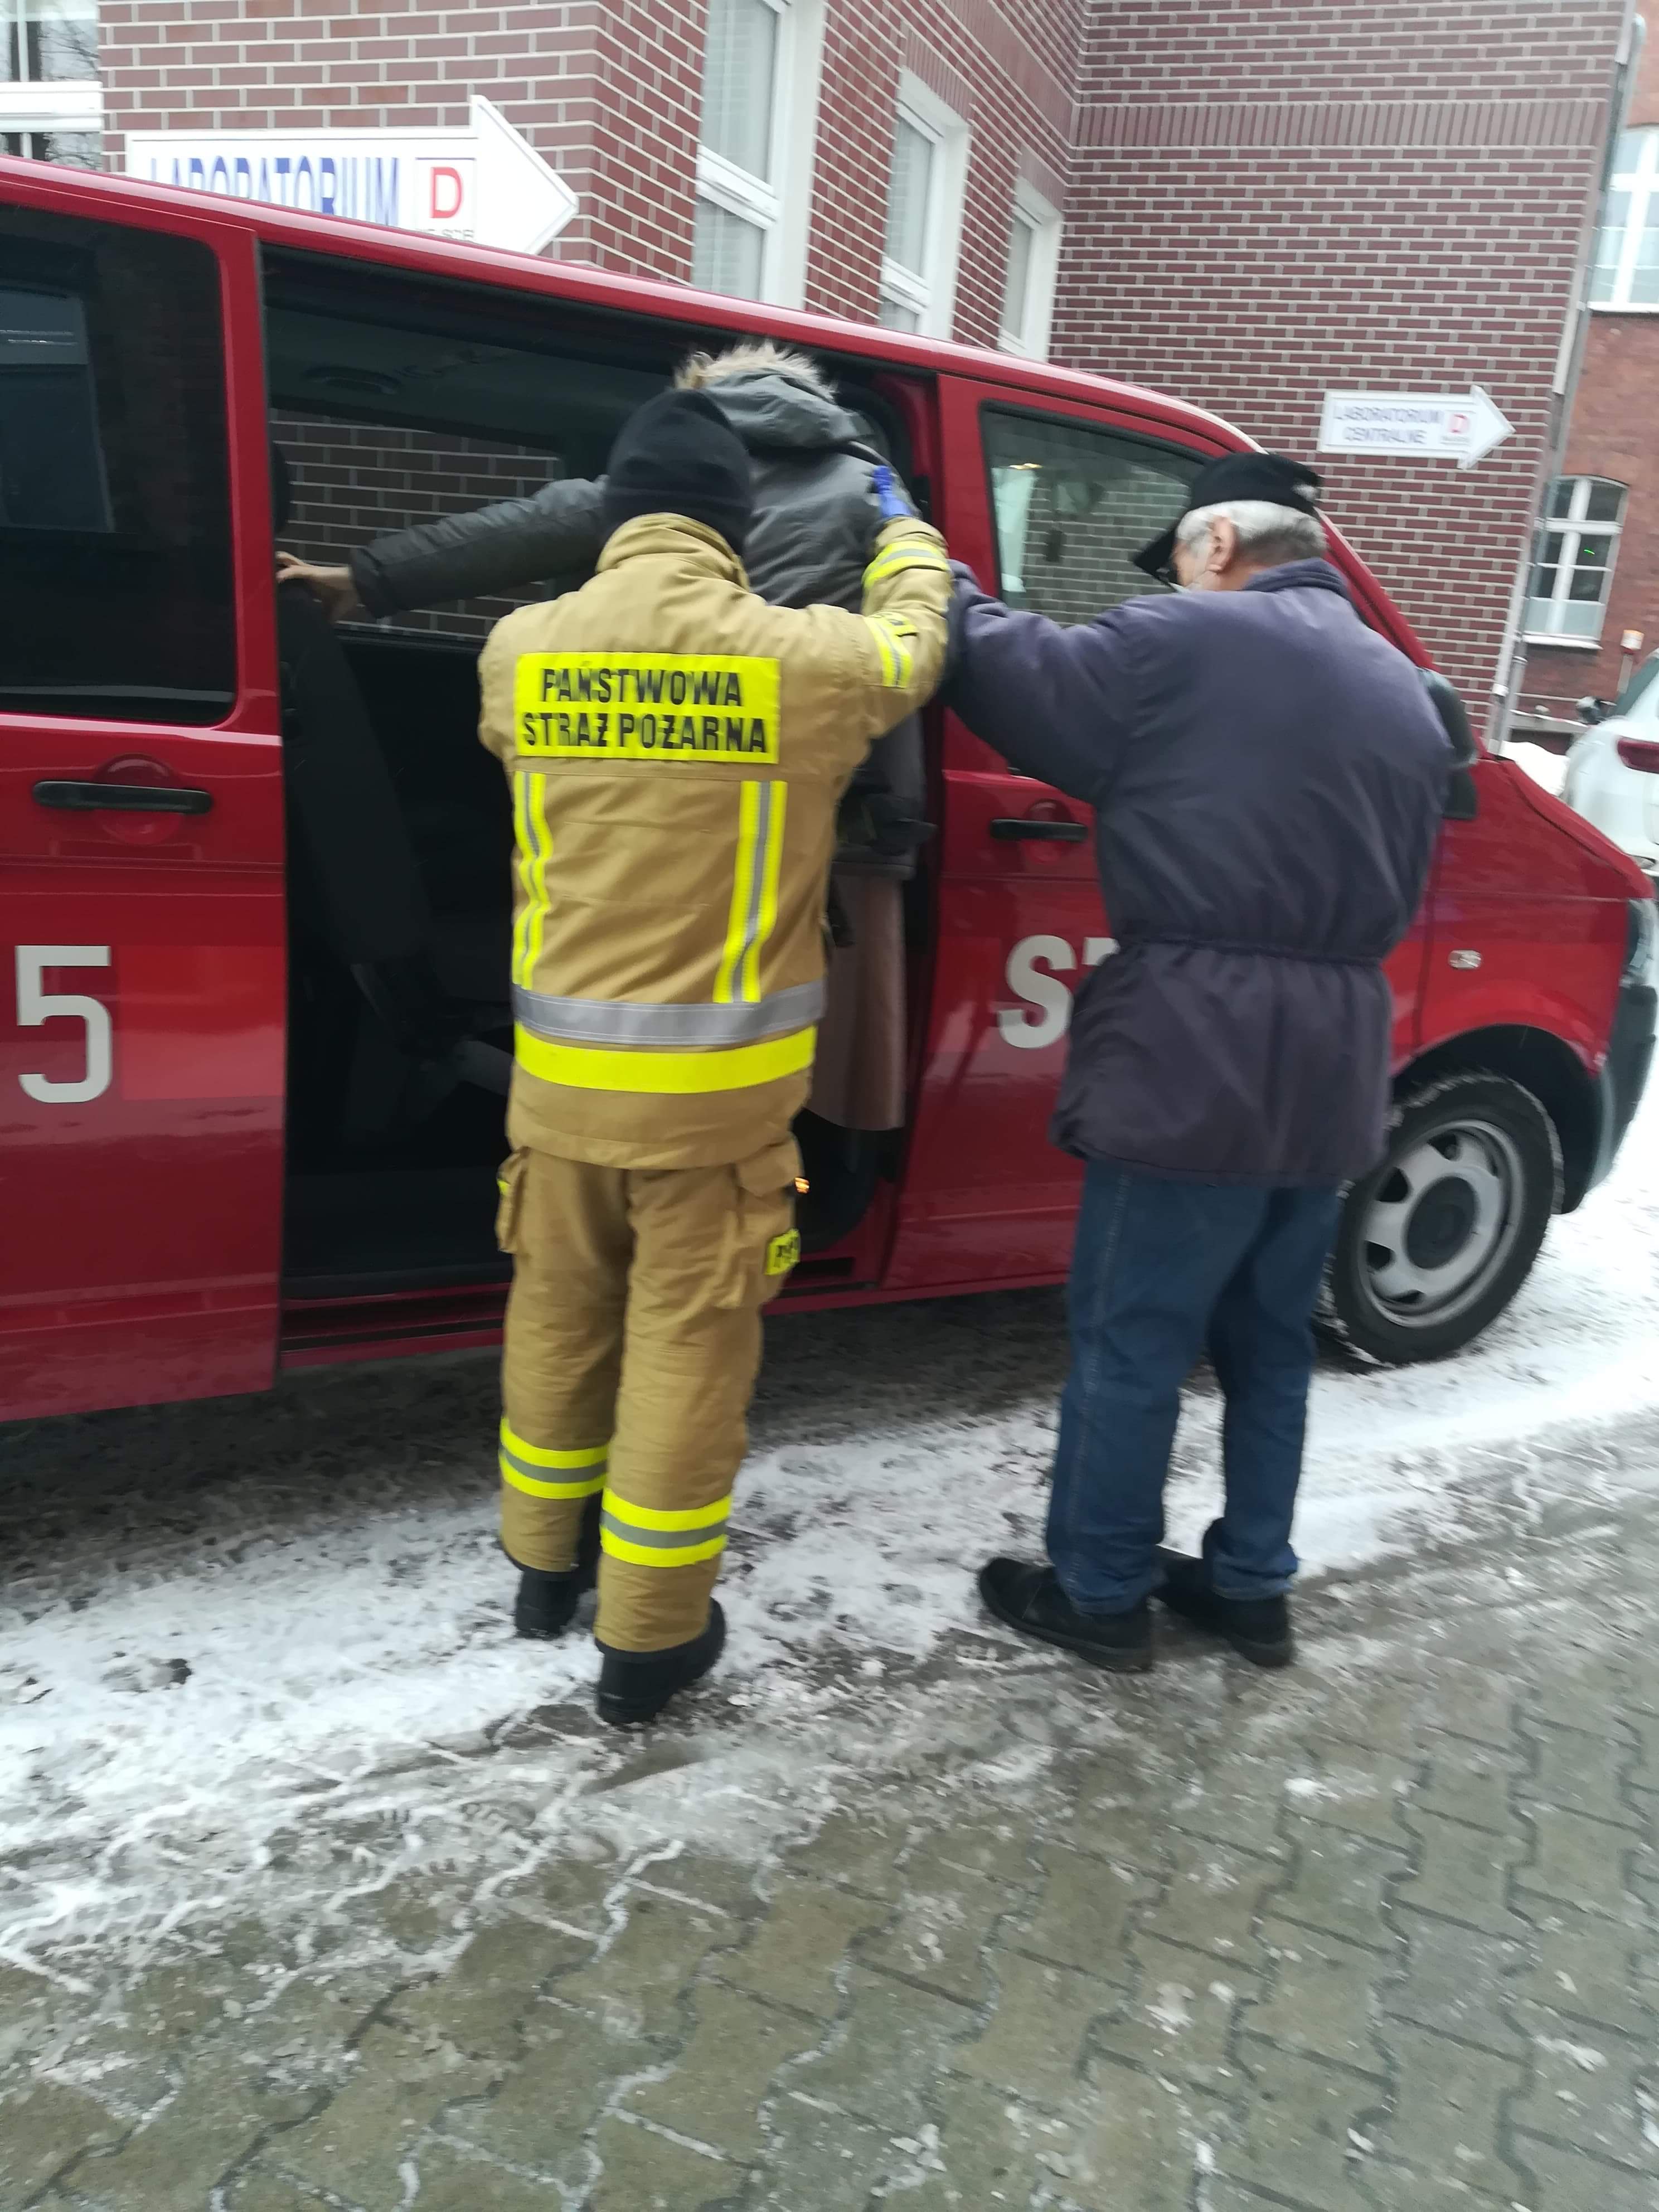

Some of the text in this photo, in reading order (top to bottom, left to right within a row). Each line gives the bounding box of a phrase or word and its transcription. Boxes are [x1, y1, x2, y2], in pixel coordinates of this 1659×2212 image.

[151, 156, 399, 226] ATORIUM
[429, 167, 463, 218] D
[541, 661, 743, 706] PAŃSTWOWA
[15, 945, 113, 1103] 5
